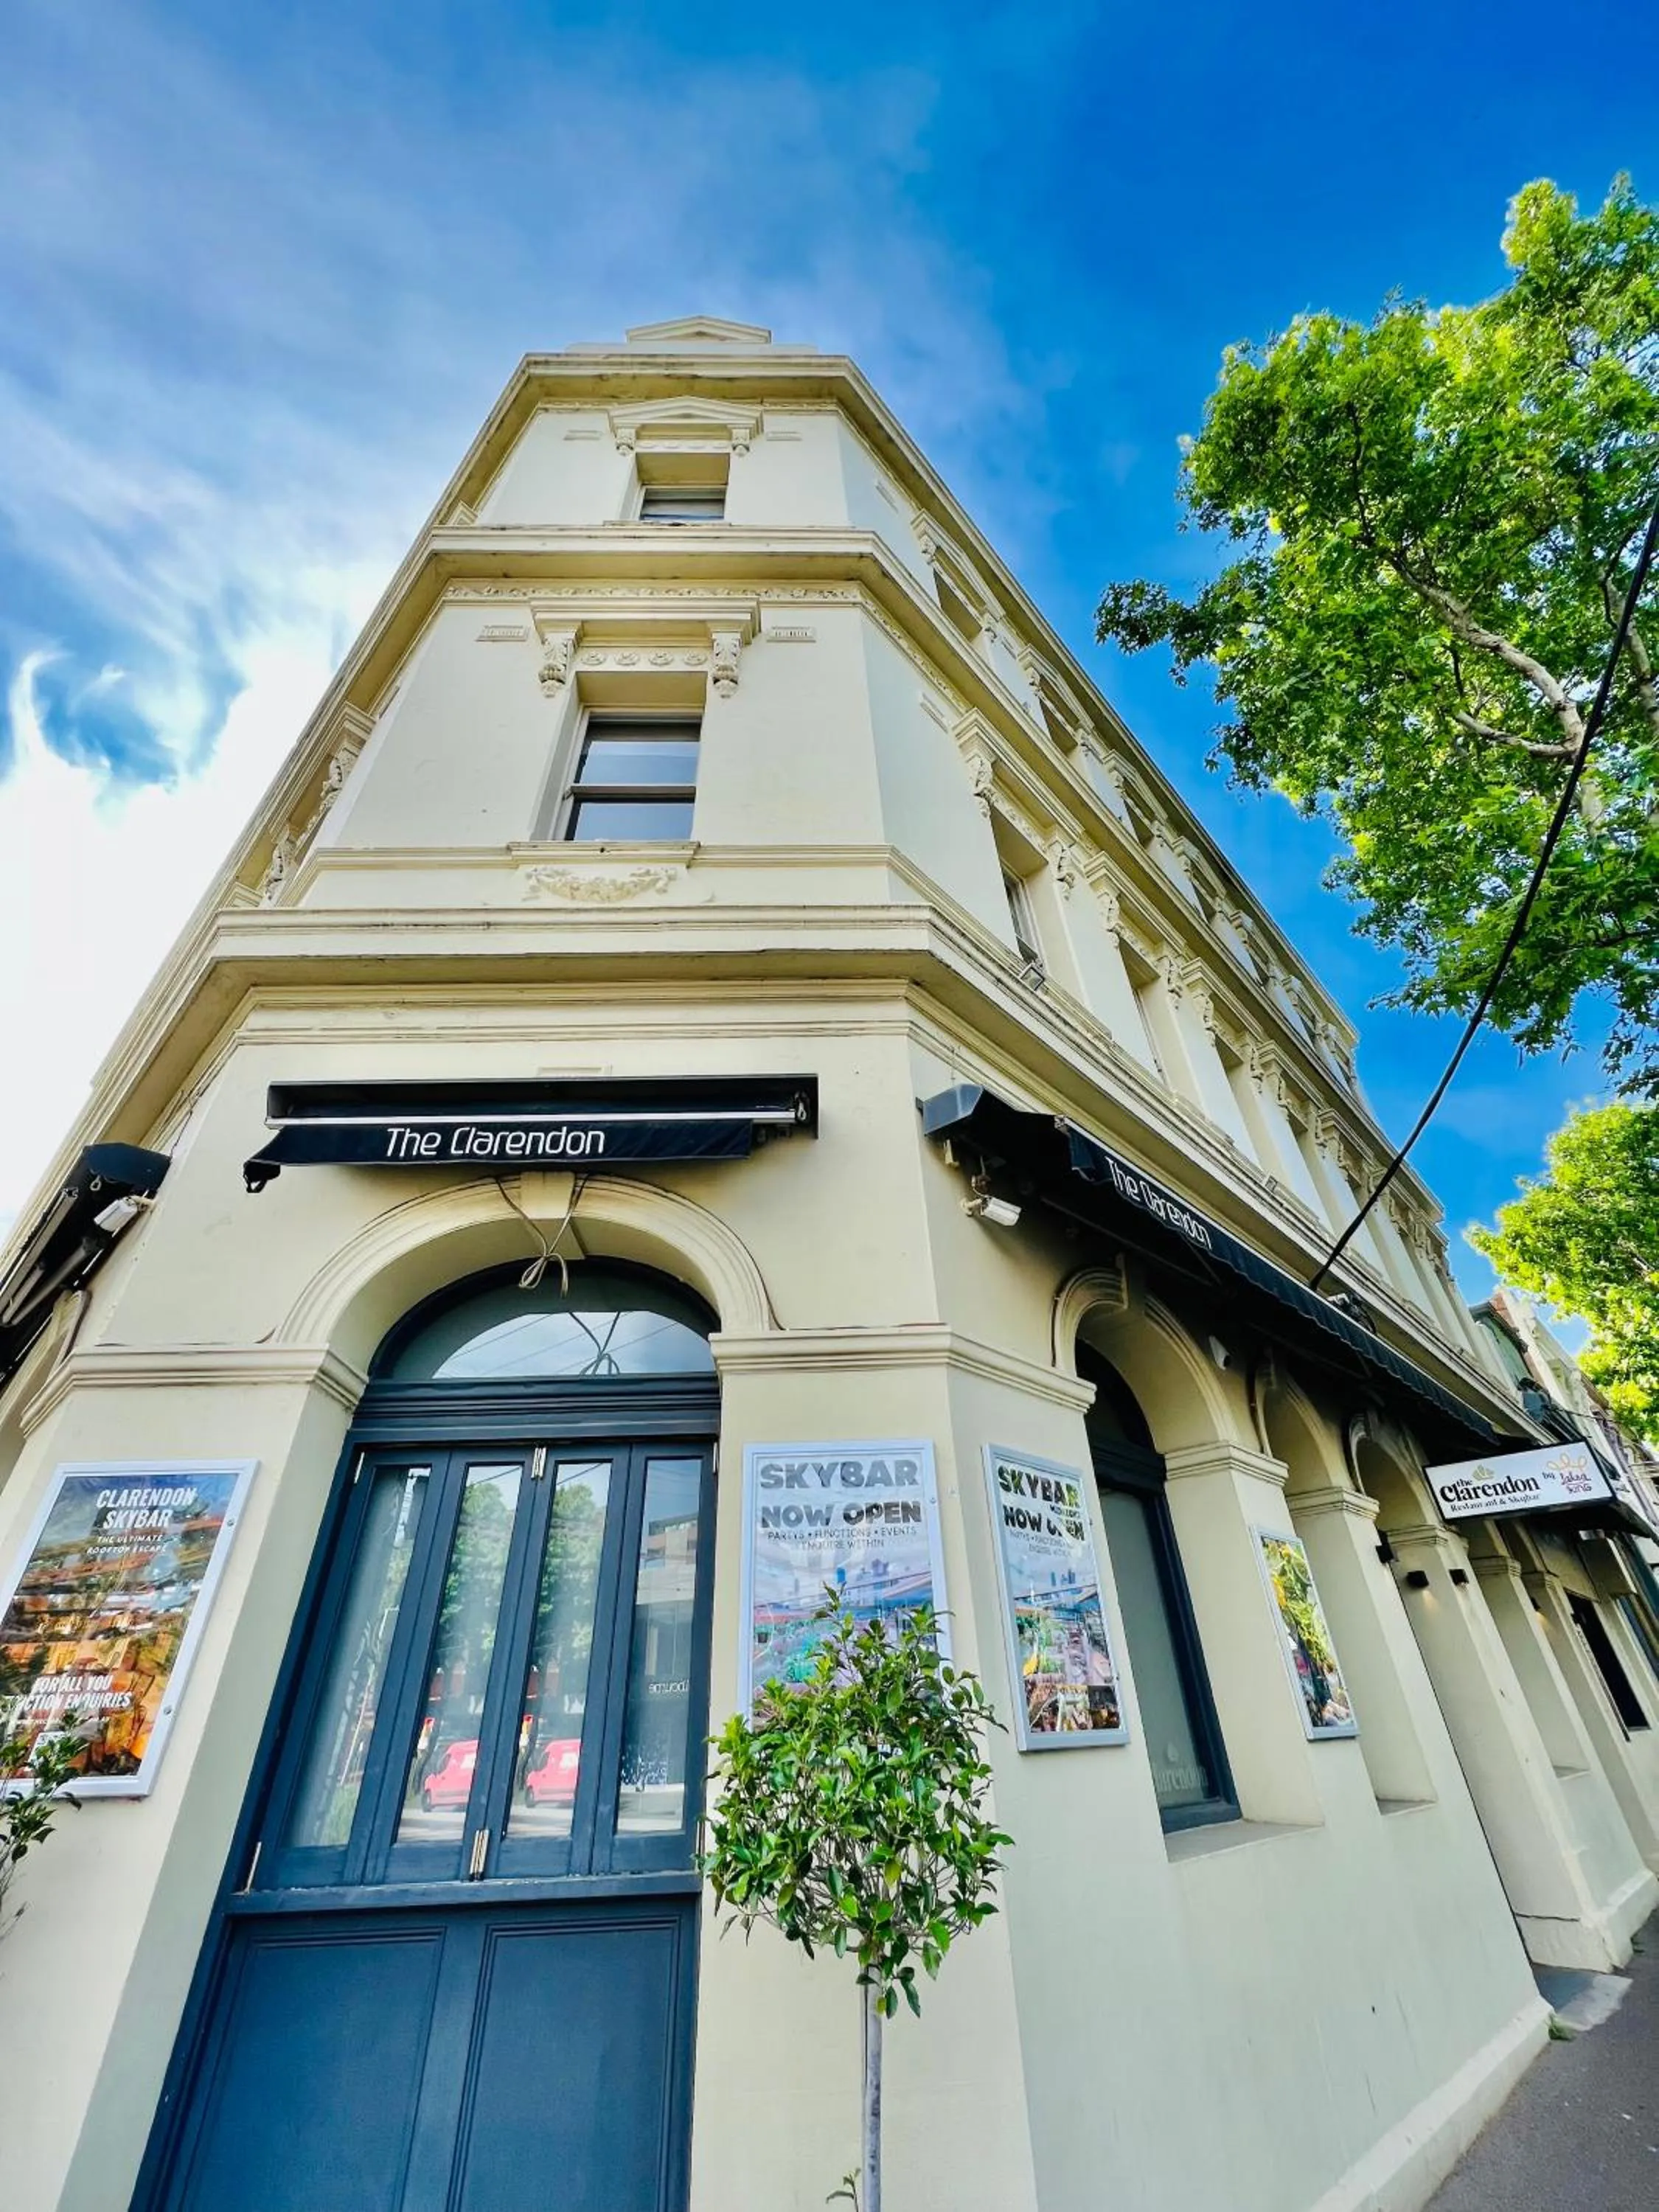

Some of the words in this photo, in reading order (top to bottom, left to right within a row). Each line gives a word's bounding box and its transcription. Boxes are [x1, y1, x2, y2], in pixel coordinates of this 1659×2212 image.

[387, 1127, 441, 1157] The
[451, 1126, 605, 1155] Clarendon
[1105, 1155, 1141, 1201] The
[1139, 1180, 1212, 1251] Clarendon
[760, 1460, 918, 1488] SKYBAR
[1455, 1478, 1472, 1487] the
[998, 1465, 1080, 1507] SKYBAR
[1439, 1476, 1541, 1503] Clarendon
[97, 1487, 198, 1508] CLARENDON
[103, 1510, 173, 1528] SKYBAR
[761, 1505, 834, 1528] NOW
[843, 1501, 921, 1526] OPEN
[1003, 1504, 1042, 1532] NOW
[1046, 1517, 1085, 1541] OEN
[116, 1534, 163, 1544] ULTIMATE
[814, 1526, 871, 1539] FUNCTIONS
[880, 1526, 917, 1537] EVENTS
[86, 1545, 131, 1555] ROOFTOP
[847, 1538, 884, 1548] WITHIN
[61, 1675, 83, 1692] ALL
[66, 1692, 133, 1709] ENQUIRIES
